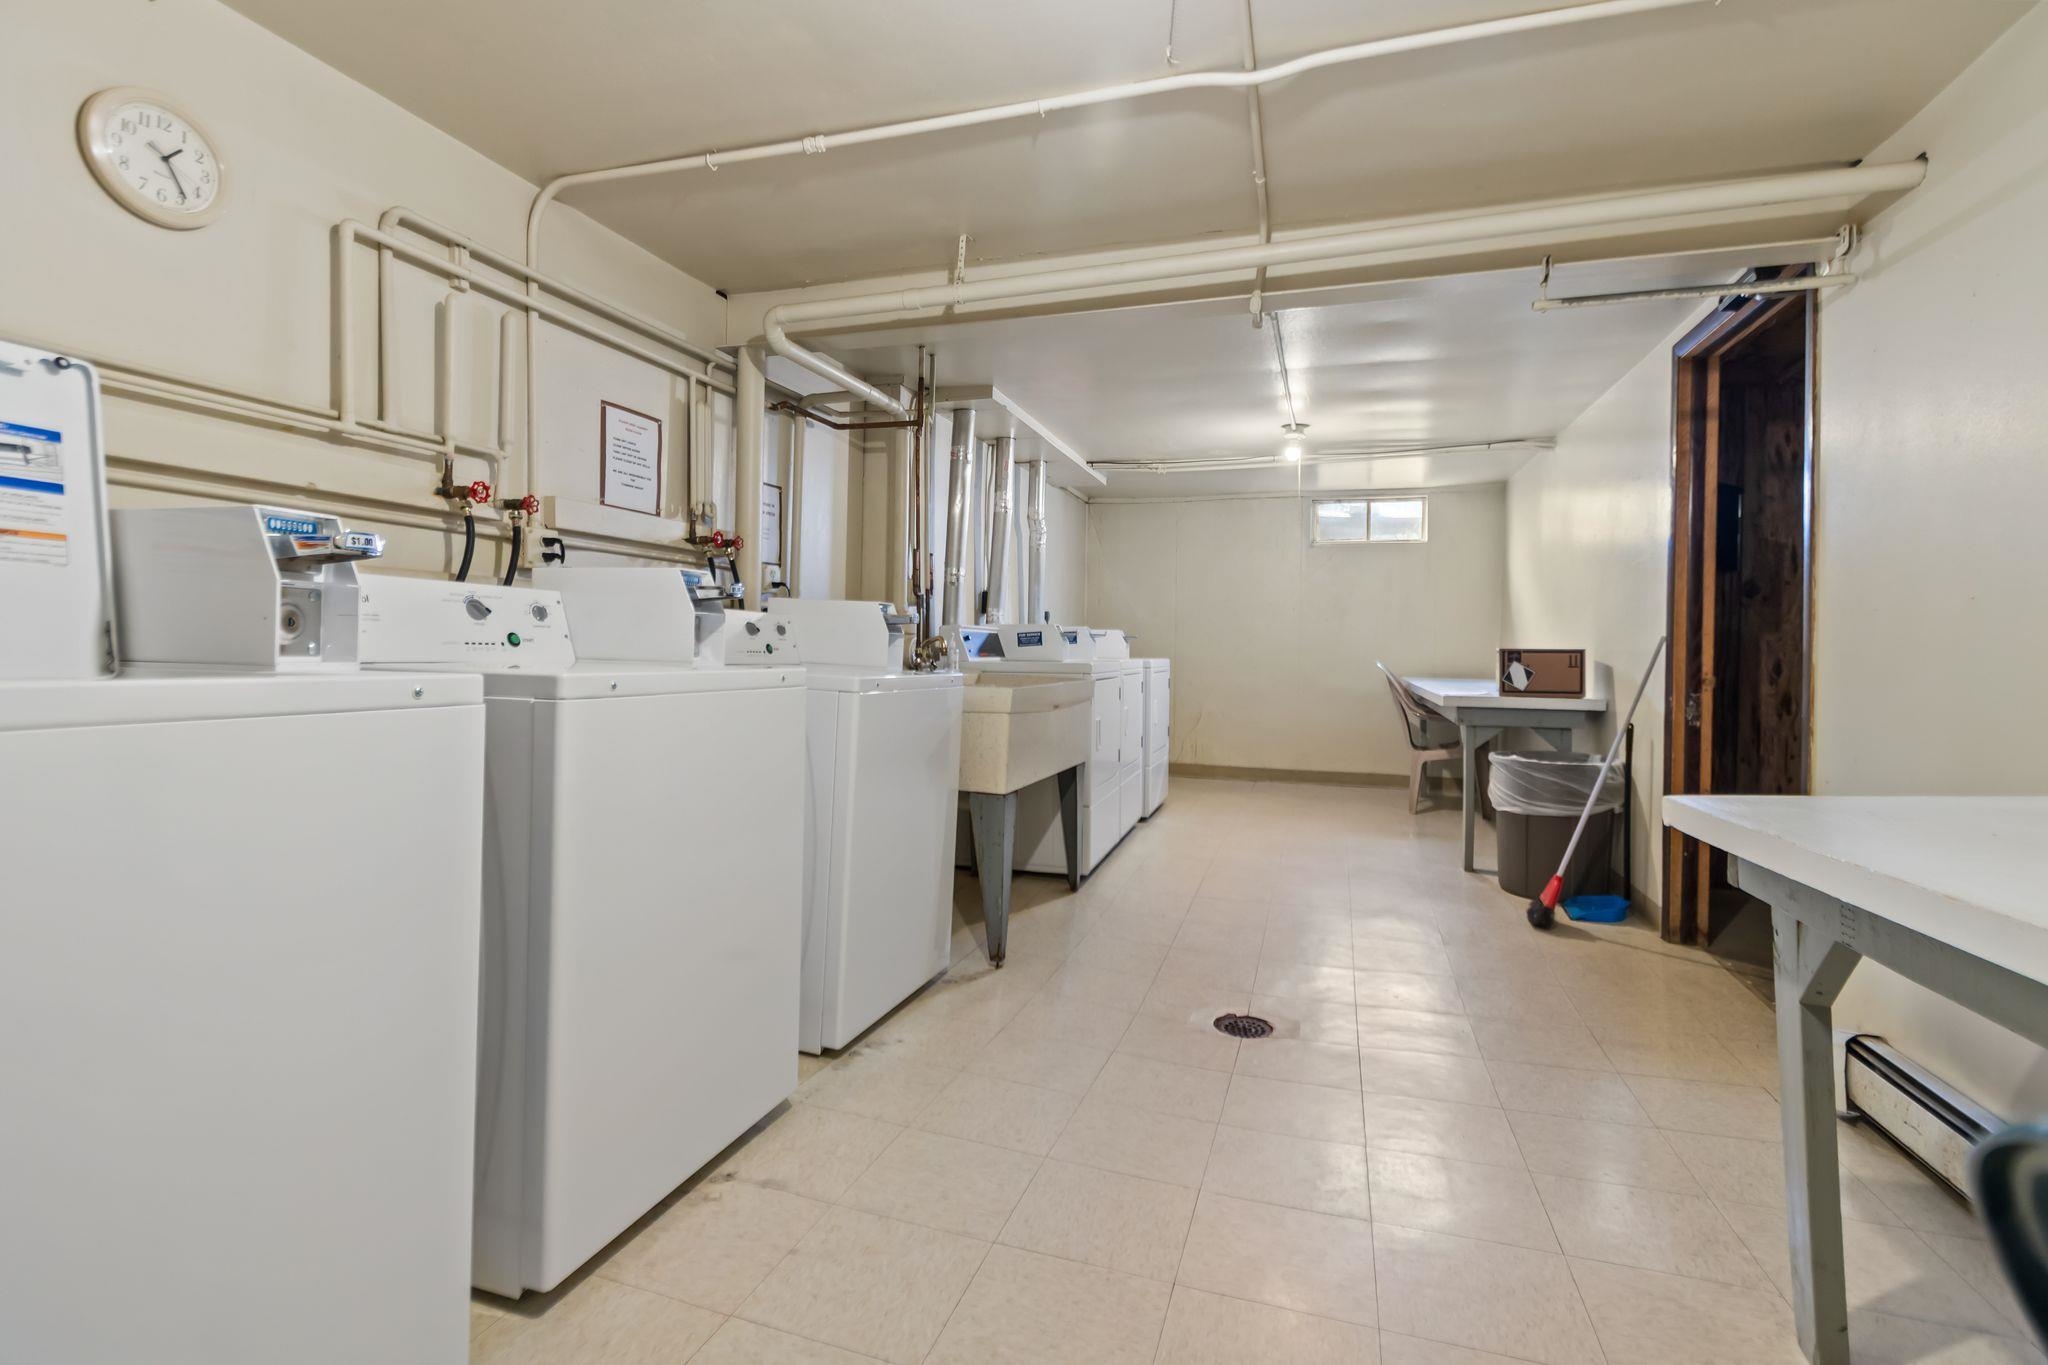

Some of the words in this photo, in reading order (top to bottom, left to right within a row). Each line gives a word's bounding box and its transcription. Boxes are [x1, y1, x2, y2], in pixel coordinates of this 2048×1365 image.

[139, 111, 150, 128] 11
[157, 114, 172, 133] 12
[195, 150, 204, 165] 2
[138, 175, 149, 190] 7
[201, 170, 210, 184] 3
[156, 188, 167, 202] 6
